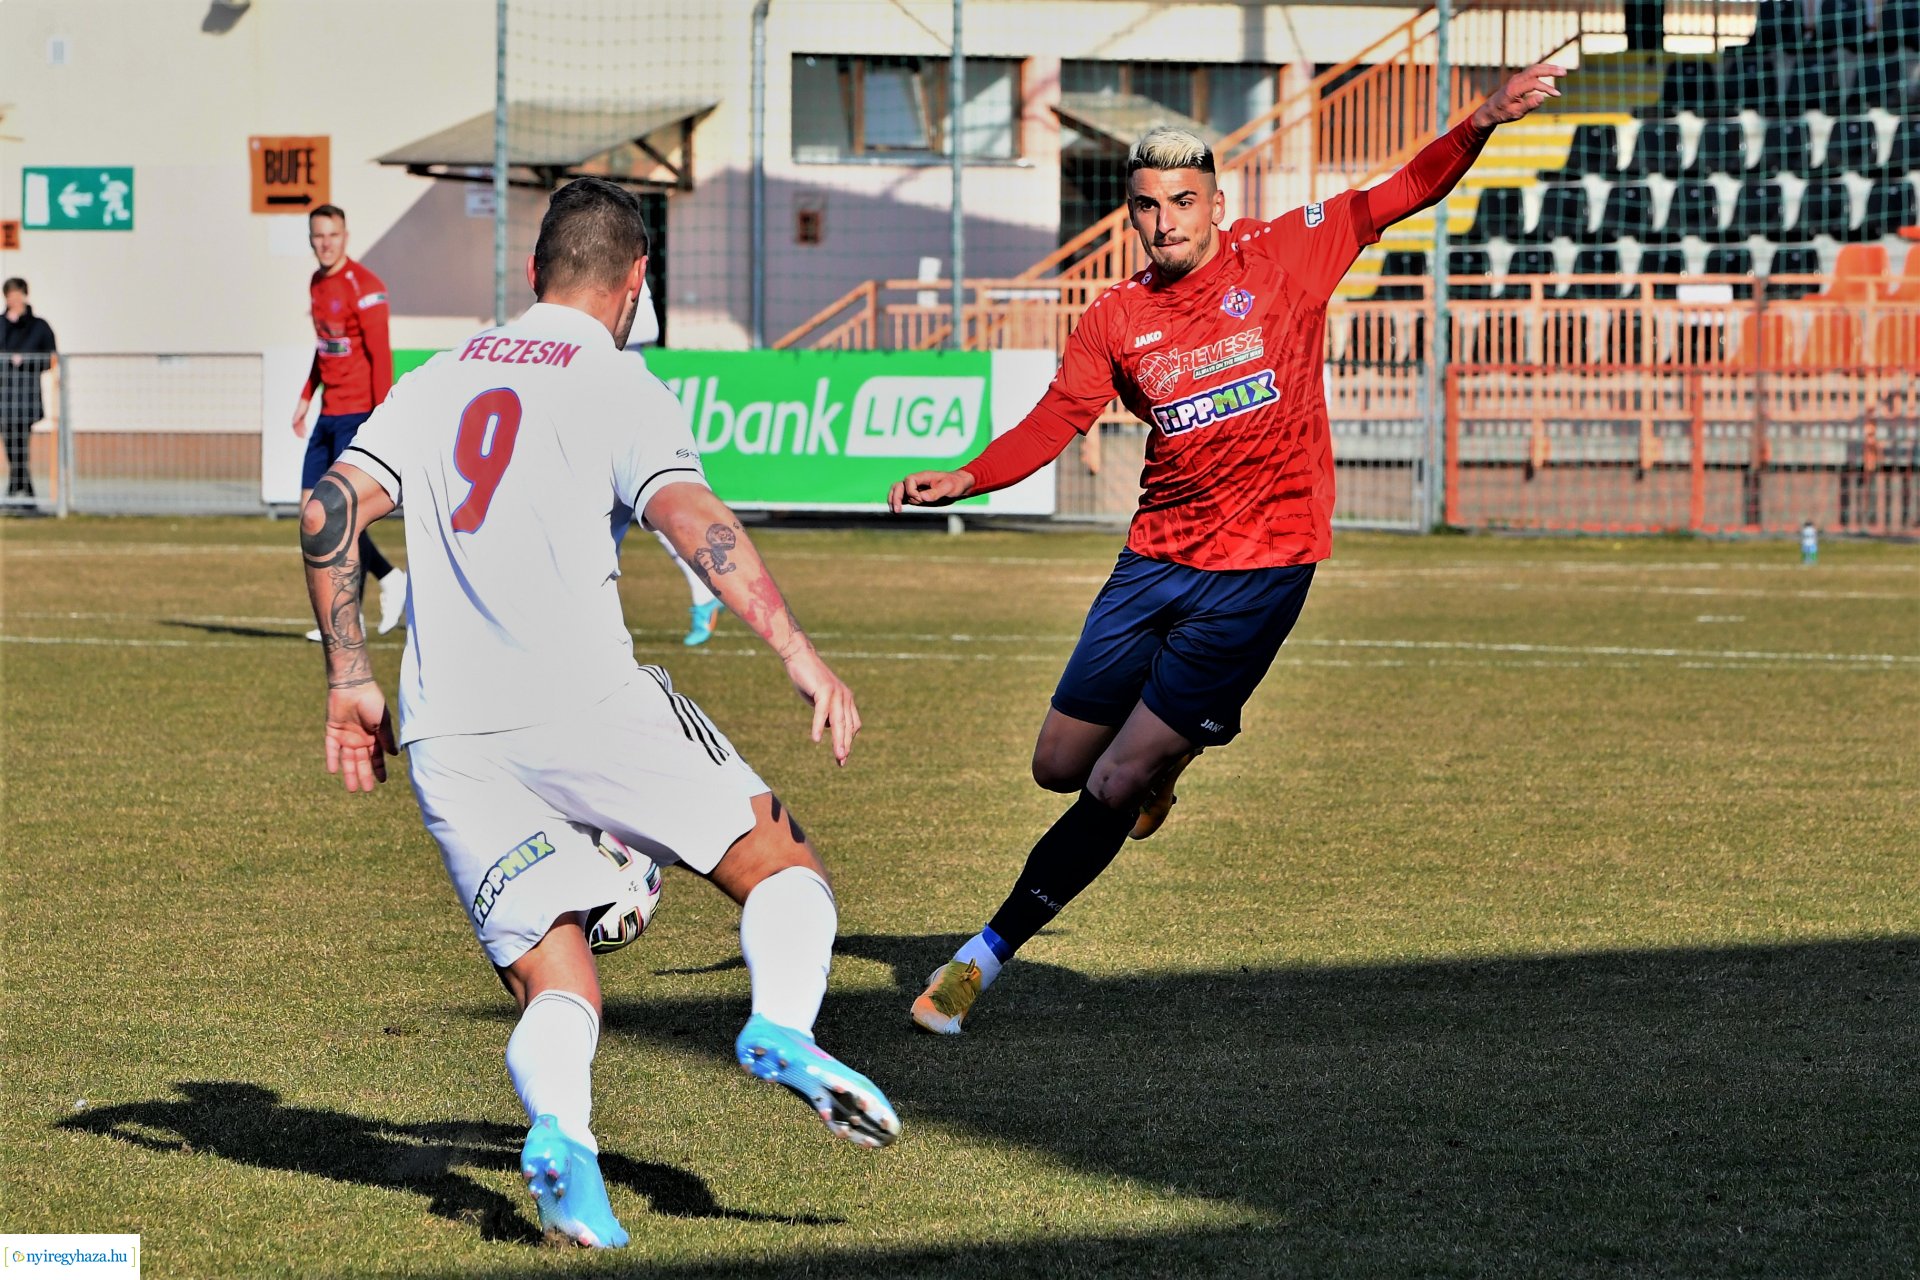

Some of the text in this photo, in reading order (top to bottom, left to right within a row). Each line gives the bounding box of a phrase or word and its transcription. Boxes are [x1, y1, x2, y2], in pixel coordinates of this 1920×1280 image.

[459, 335, 582, 368] FECZESIN
[1134, 330, 1162, 348] JAKO
[863, 396, 966, 438] LIGA
[451, 387, 522, 535] 9
